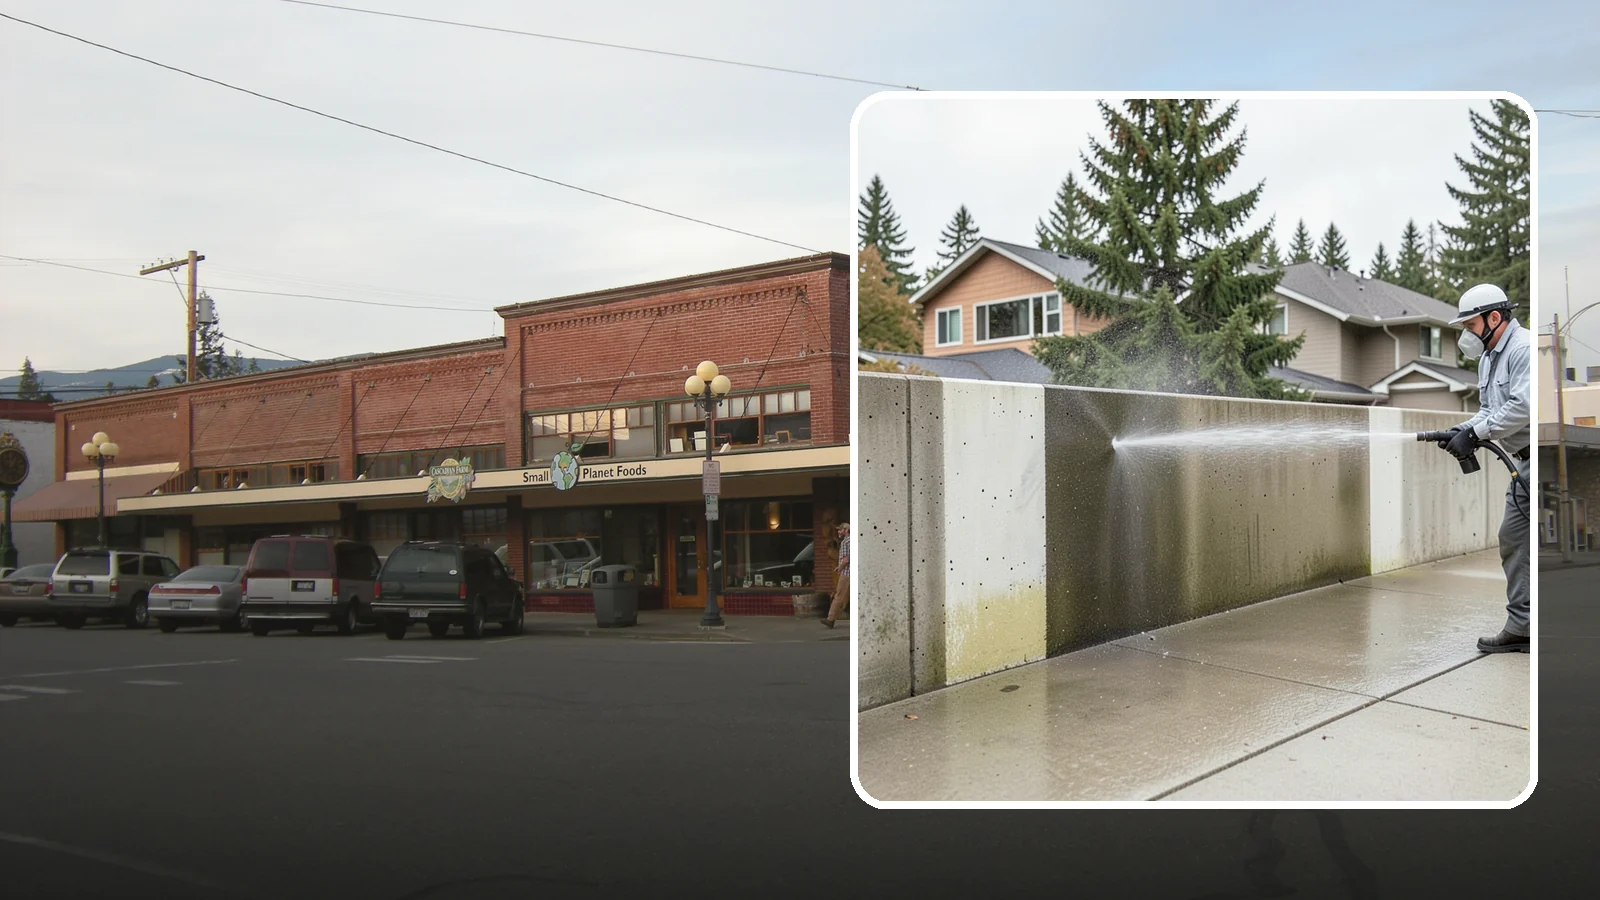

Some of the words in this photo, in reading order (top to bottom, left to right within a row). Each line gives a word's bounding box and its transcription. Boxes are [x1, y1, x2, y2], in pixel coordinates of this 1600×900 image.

[523, 471, 549, 483] Small
[583, 467, 614, 479] Planet
[617, 465, 647, 477] Foods
